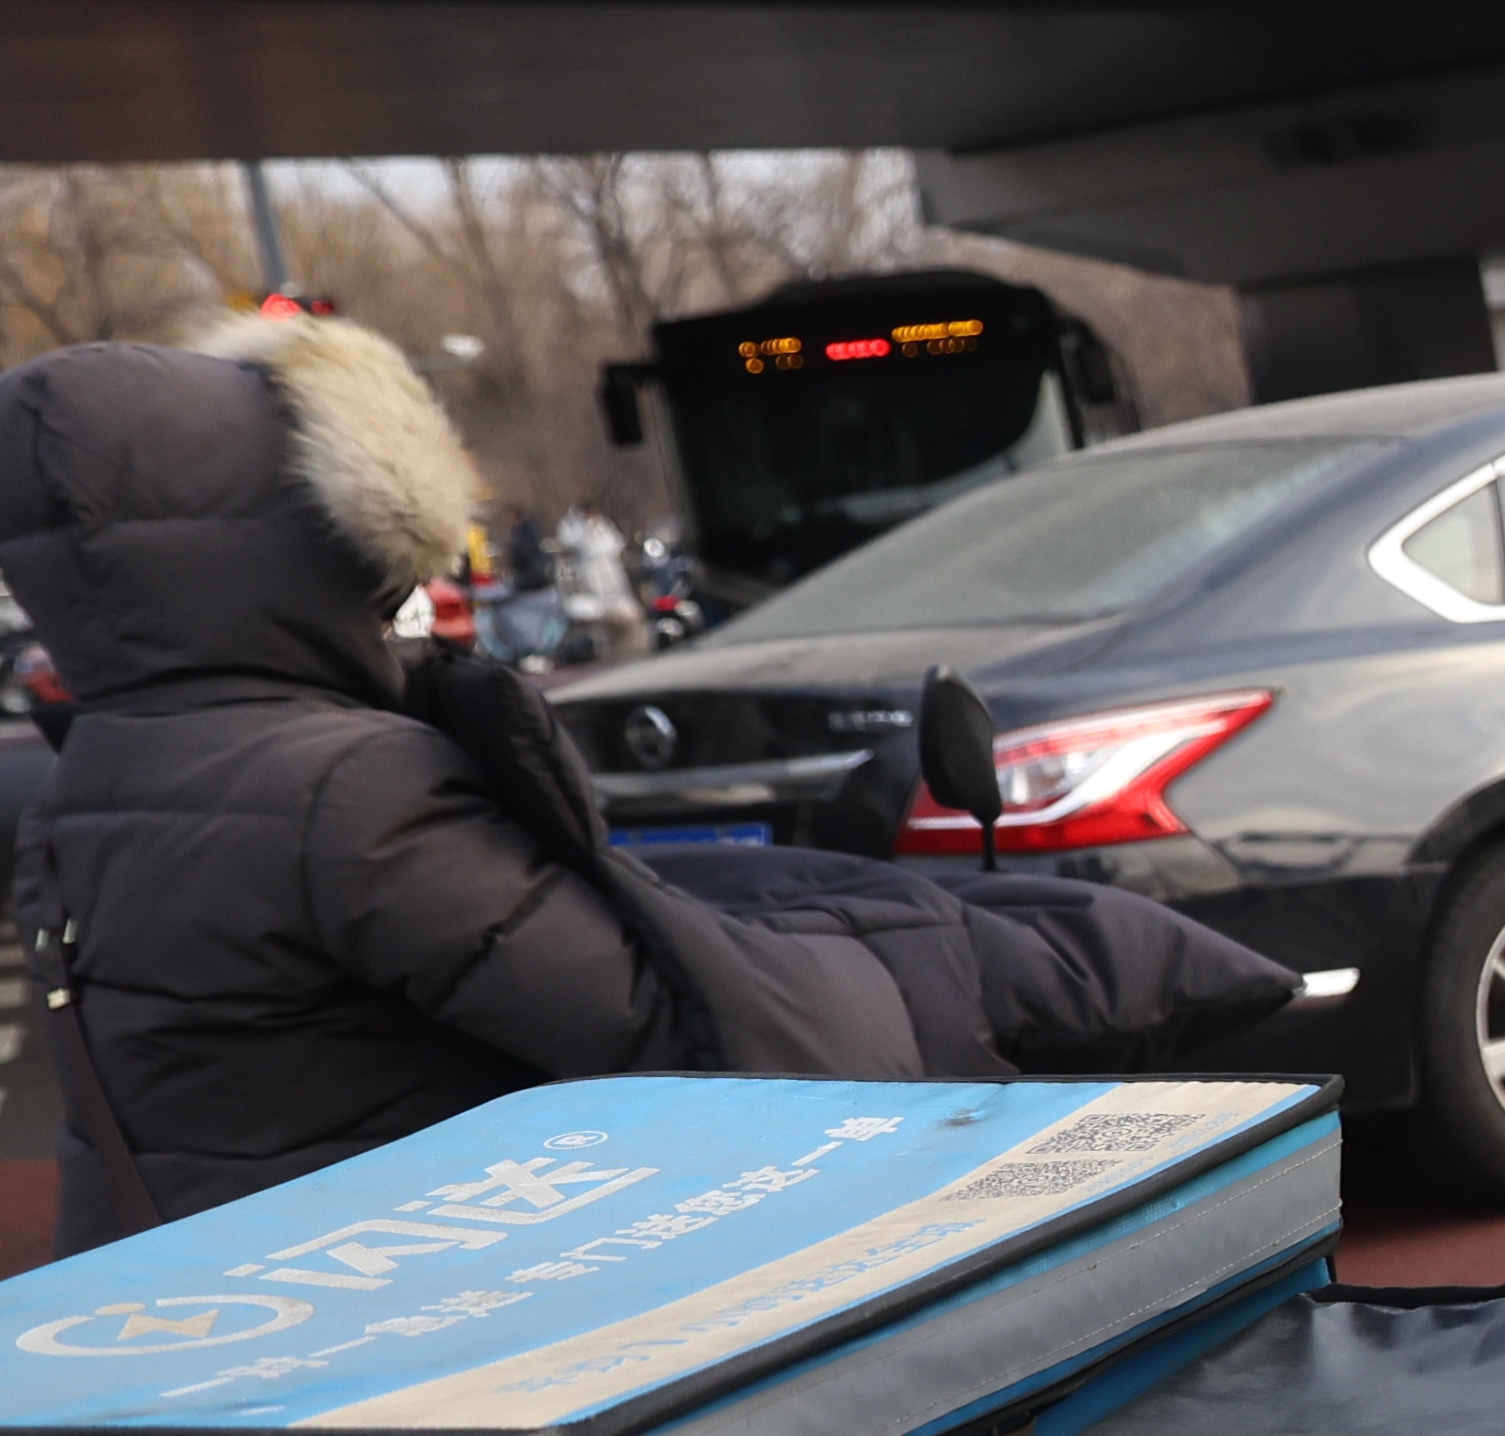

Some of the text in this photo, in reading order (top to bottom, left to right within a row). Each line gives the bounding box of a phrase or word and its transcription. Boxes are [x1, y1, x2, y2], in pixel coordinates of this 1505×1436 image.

[159, 1116, 905, 1398] 一对一急送 专门送您这一单
[225, 1156, 660, 1291] 闪送
